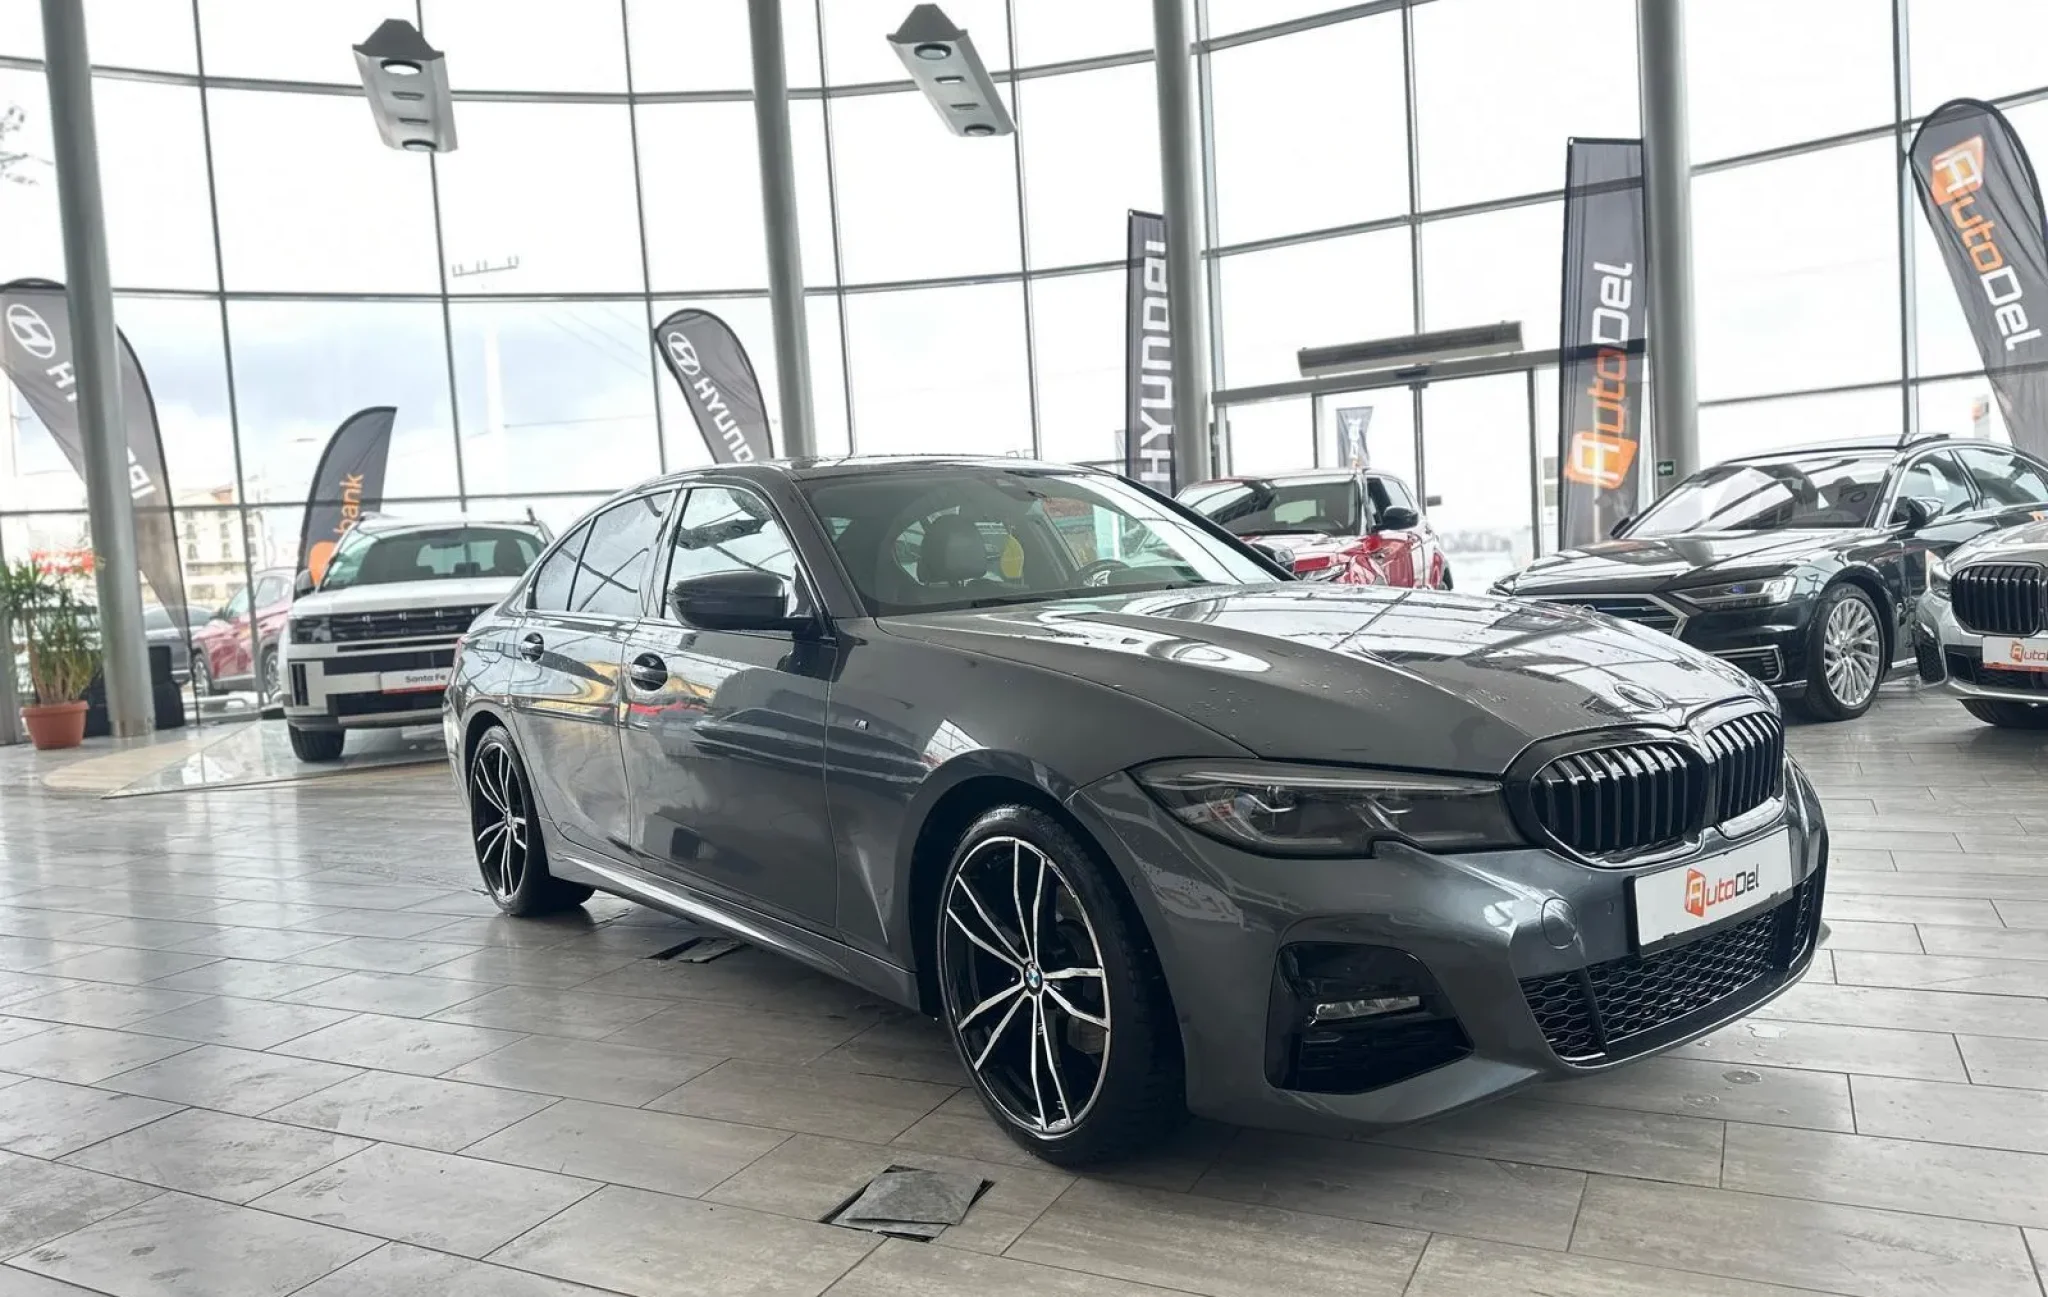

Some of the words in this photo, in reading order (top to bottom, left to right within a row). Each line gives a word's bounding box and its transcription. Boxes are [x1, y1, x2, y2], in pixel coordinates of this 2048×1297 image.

[1932, 139, 2042, 351] AutoDel
[1139, 240, 1174, 482] HYUNDAI
[1566, 261, 1635, 487] AutoDel
[694, 378, 755, 463] HYUND
[333, 473, 364, 534] bank
[405, 675, 433, 683] Santa
[2011, 641, 2048, 662] Auto
[1685, 864, 1760, 916] AutoDel
